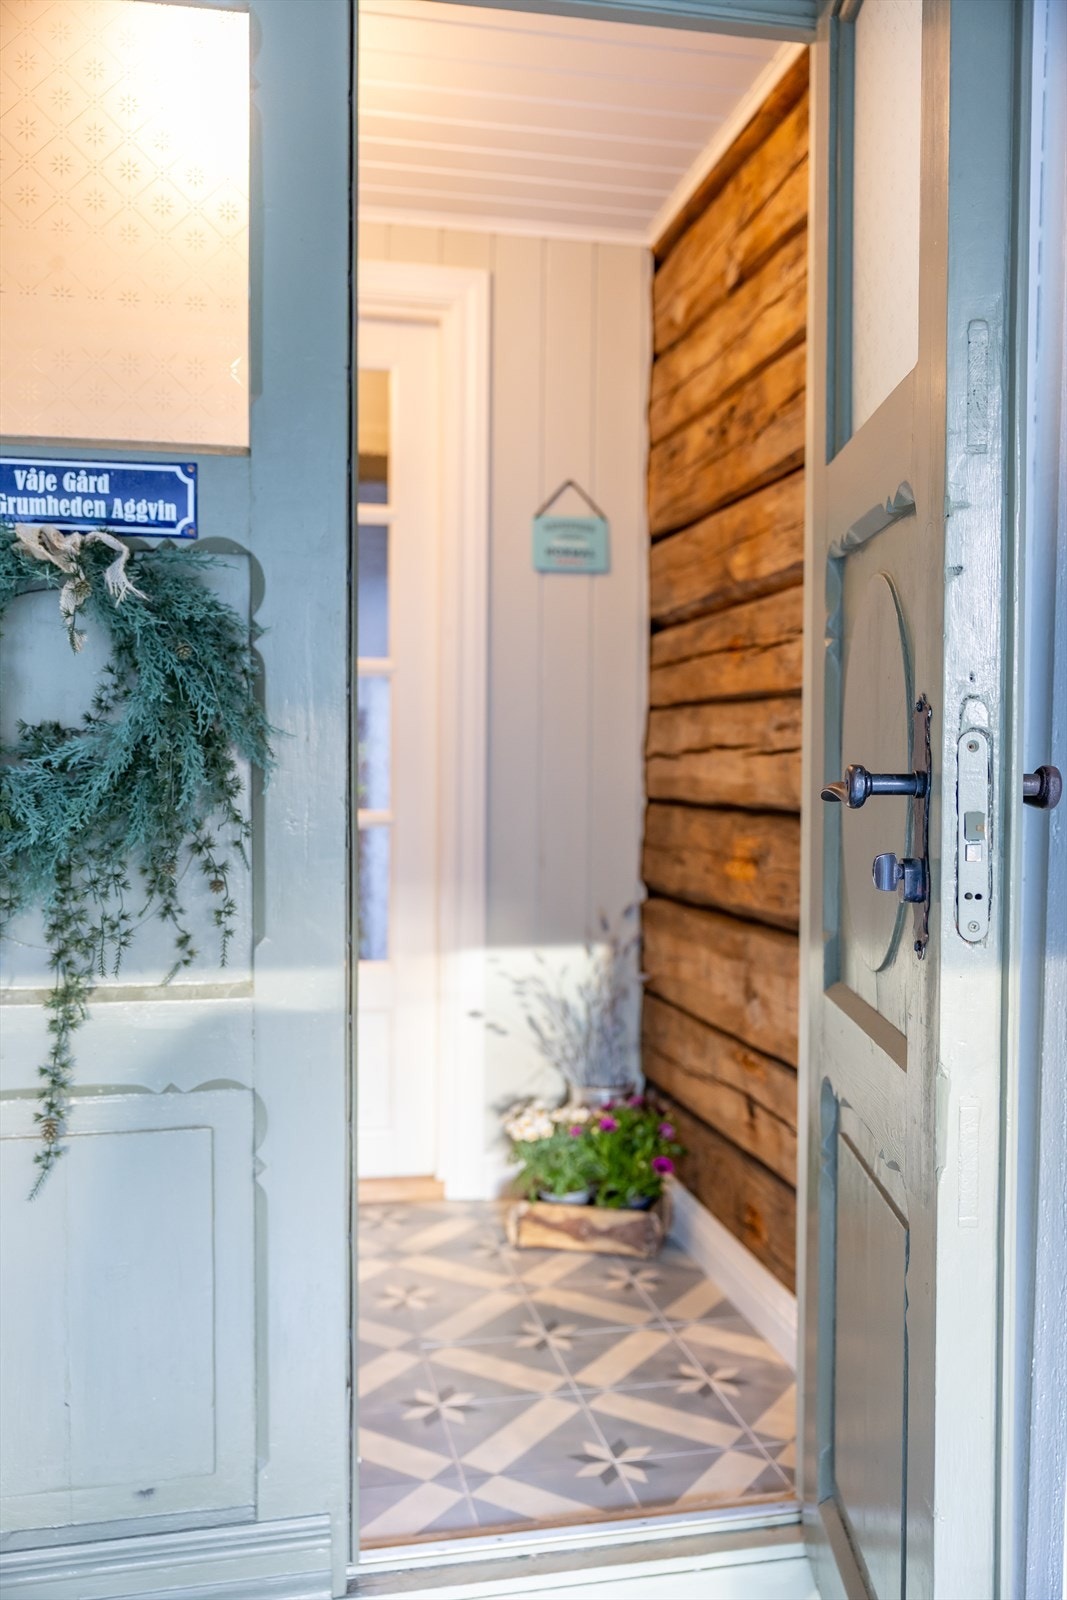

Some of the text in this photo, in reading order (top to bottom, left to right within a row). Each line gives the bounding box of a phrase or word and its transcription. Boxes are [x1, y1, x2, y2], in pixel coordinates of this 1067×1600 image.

[14, 467, 110, 494] Våje Gård
[112, 498, 177, 522] Aggvin
